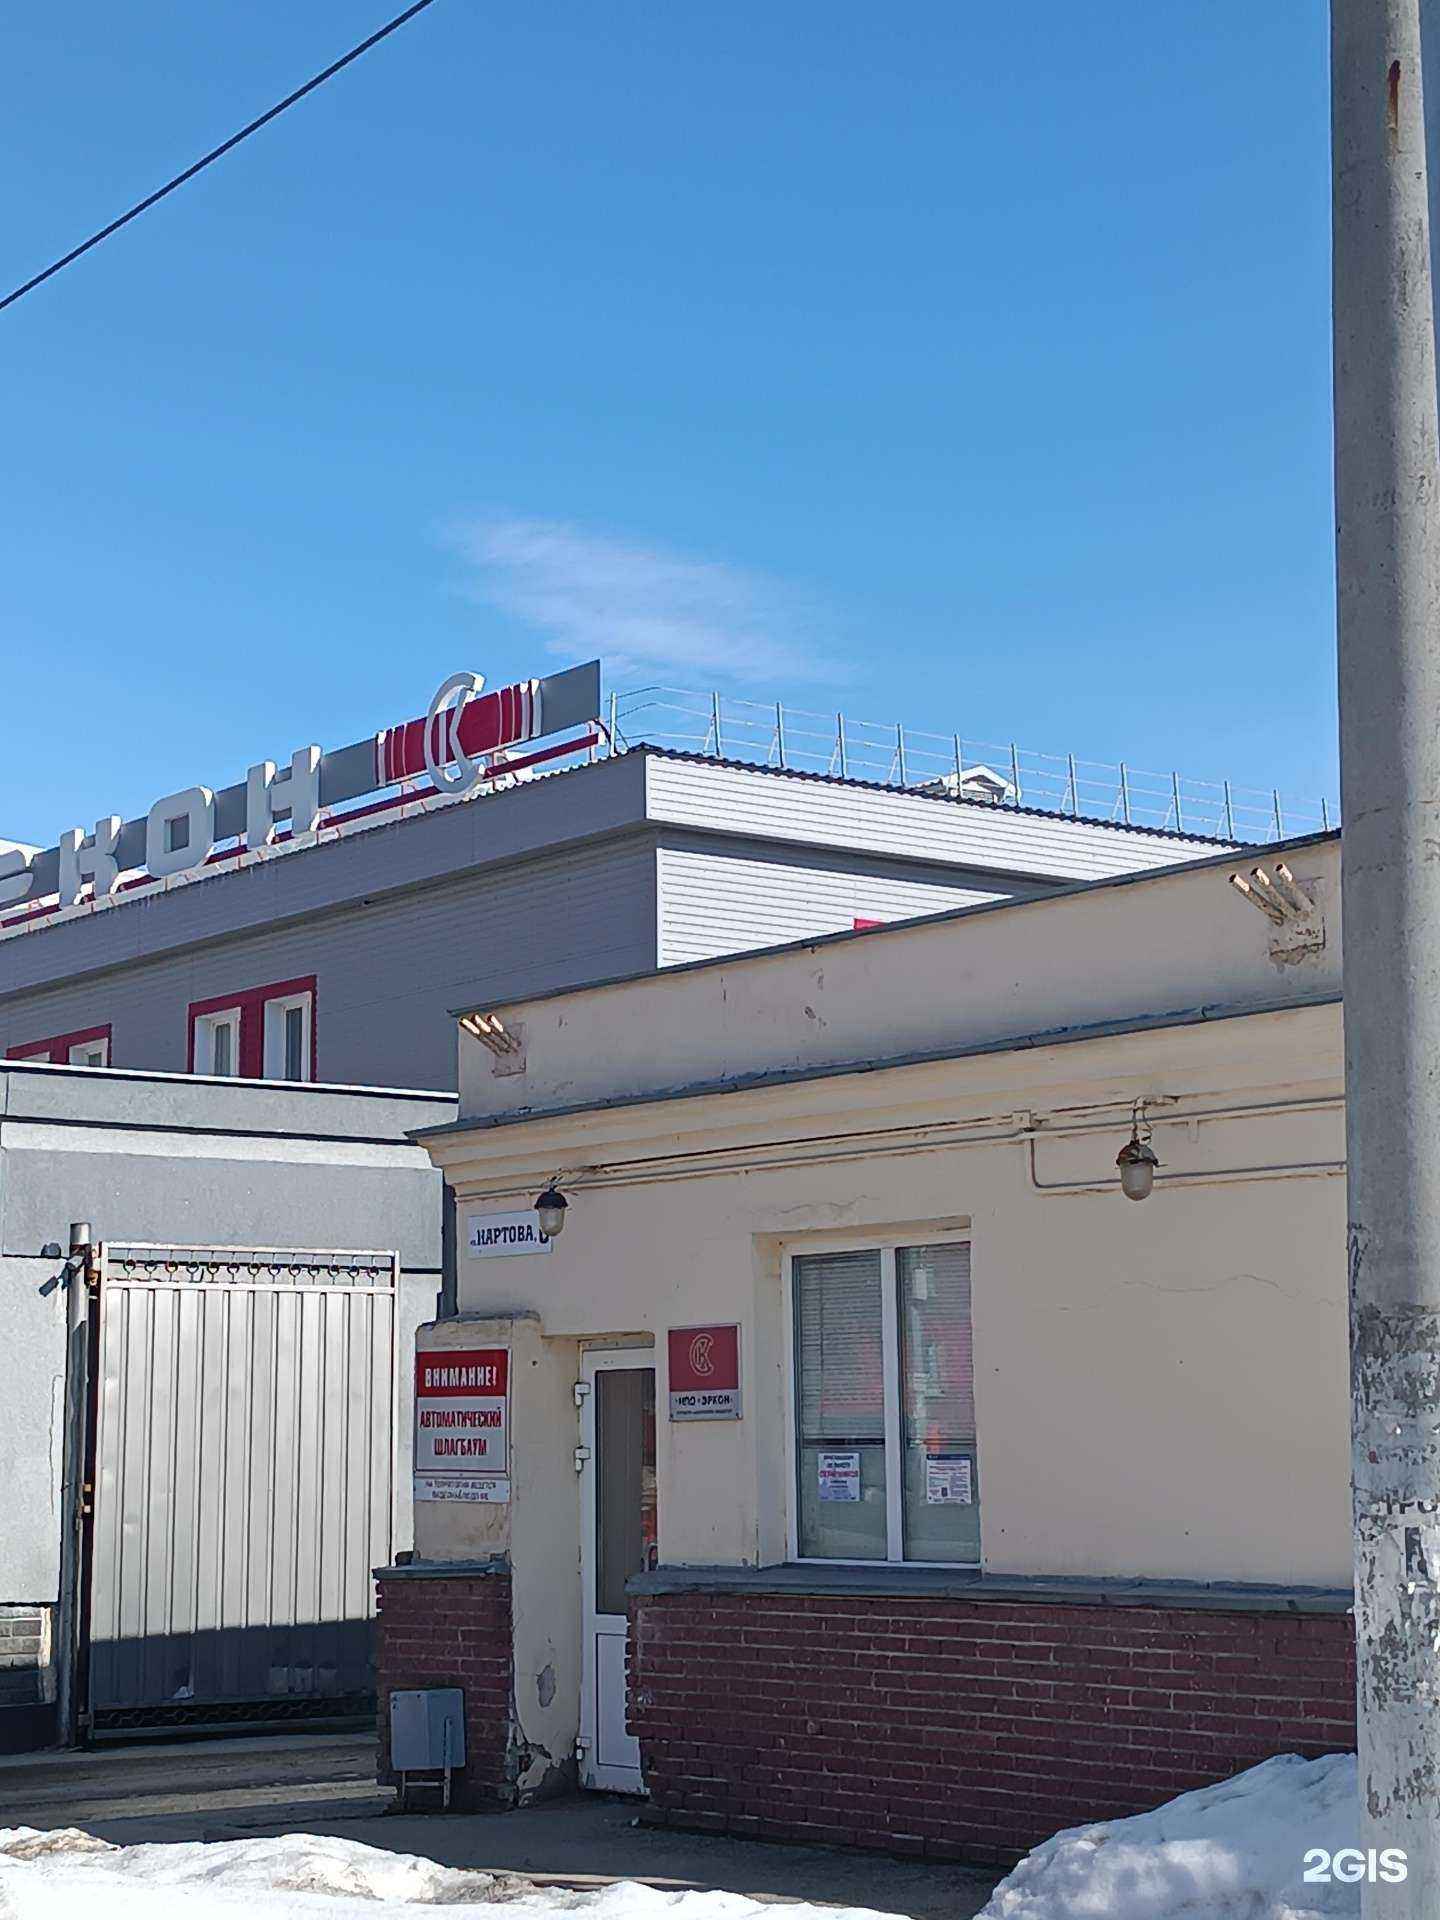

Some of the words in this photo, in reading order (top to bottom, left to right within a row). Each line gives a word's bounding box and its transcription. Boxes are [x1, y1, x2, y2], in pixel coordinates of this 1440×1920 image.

[425, 1366, 497, 1388] ВНИМАНИЕ!
[420, 1406, 502, 1428] АВТОМАТИЧЕСКИЙ
[434, 1438, 488, 1456] ШЛАГБАУМ
